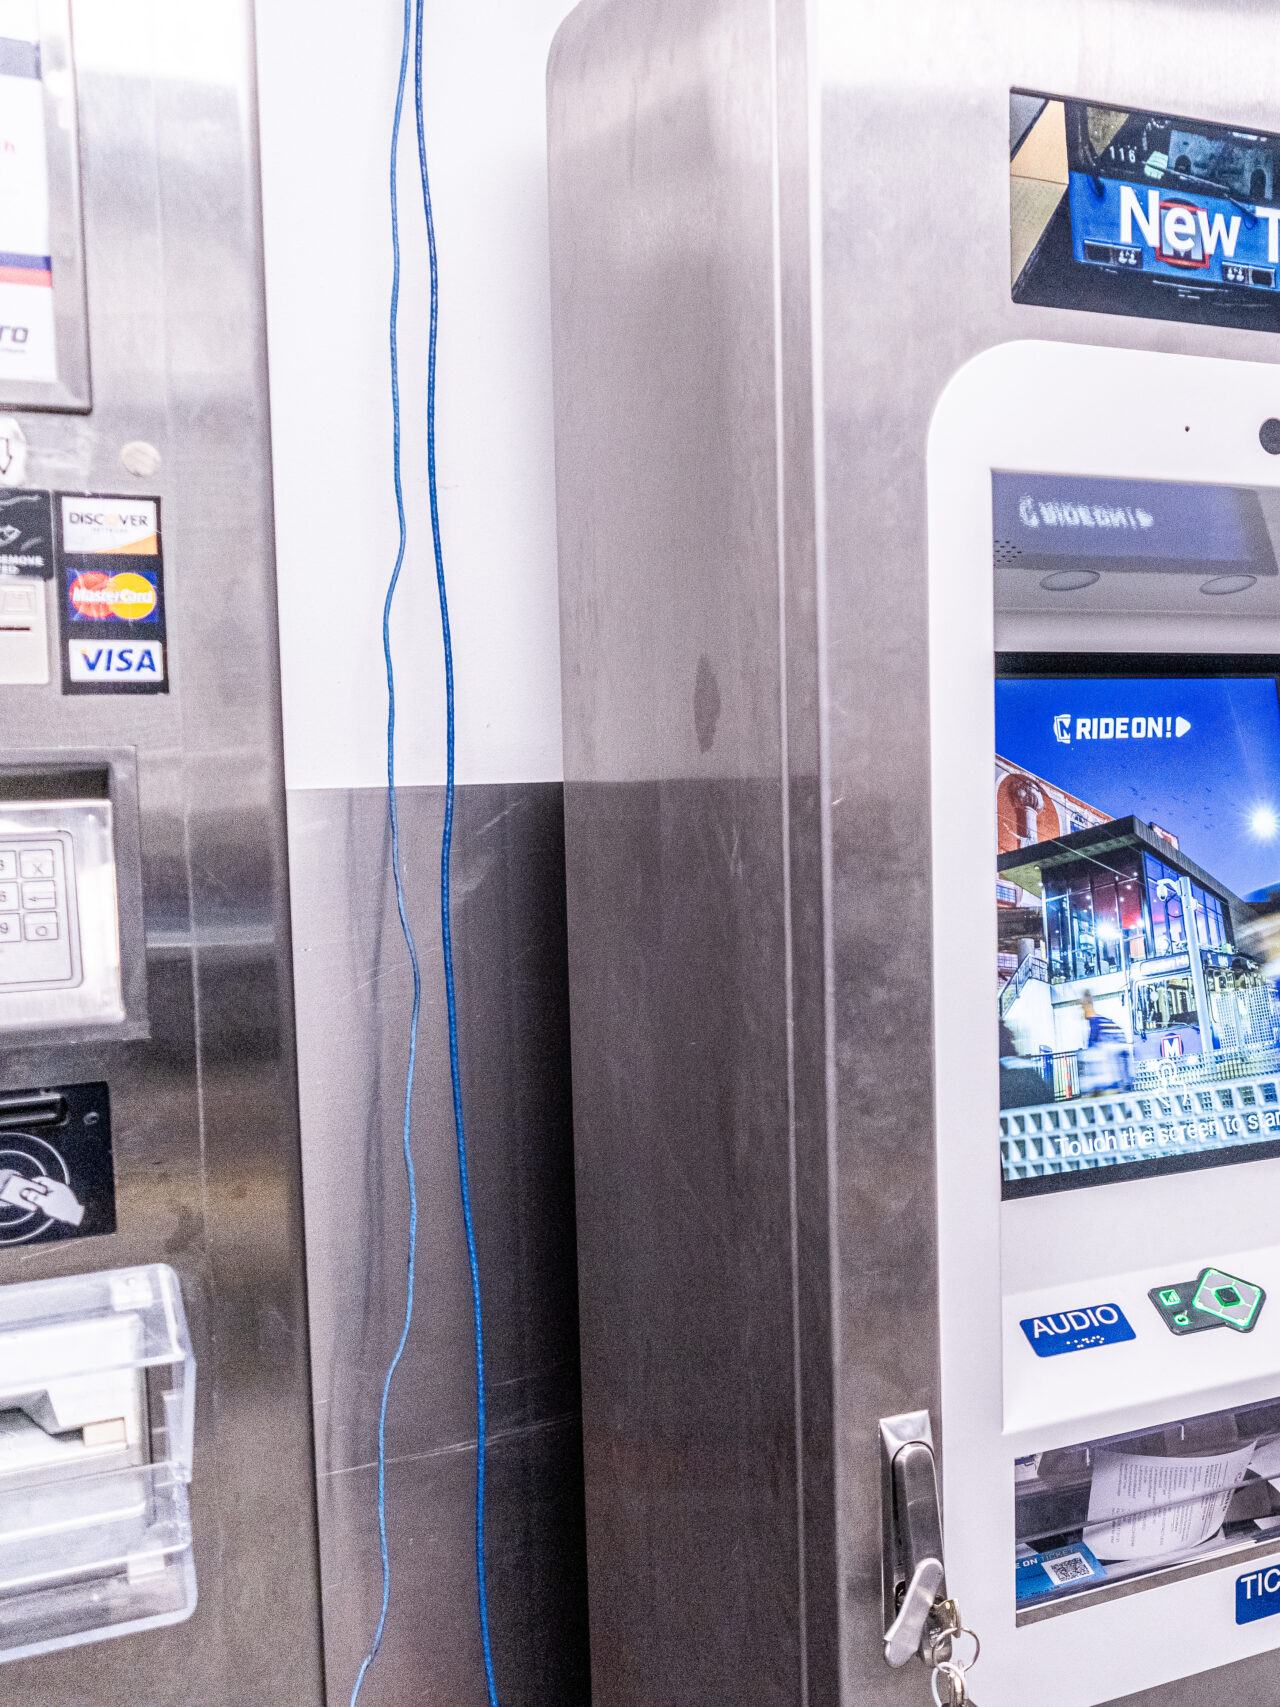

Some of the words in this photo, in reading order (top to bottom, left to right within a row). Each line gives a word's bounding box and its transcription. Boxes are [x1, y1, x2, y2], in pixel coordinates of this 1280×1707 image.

[1109, 145, 1136, 163] 116
[1119, 185, 1242, 257] New
[69, 511, 148, 527] DISCOVER
[73, 587, 154, 604] MasterCard
[80, 648, 156, 672] VISA
[1055, 1130, 1117, 1158] Touch
[1121, 1127, 1154, 1147] the
[1159, 1120, 1220, 1145] screen
[1224, 1115, 1243, 1133] to
[1032, 1305, 1120, 1339] AUDIO
